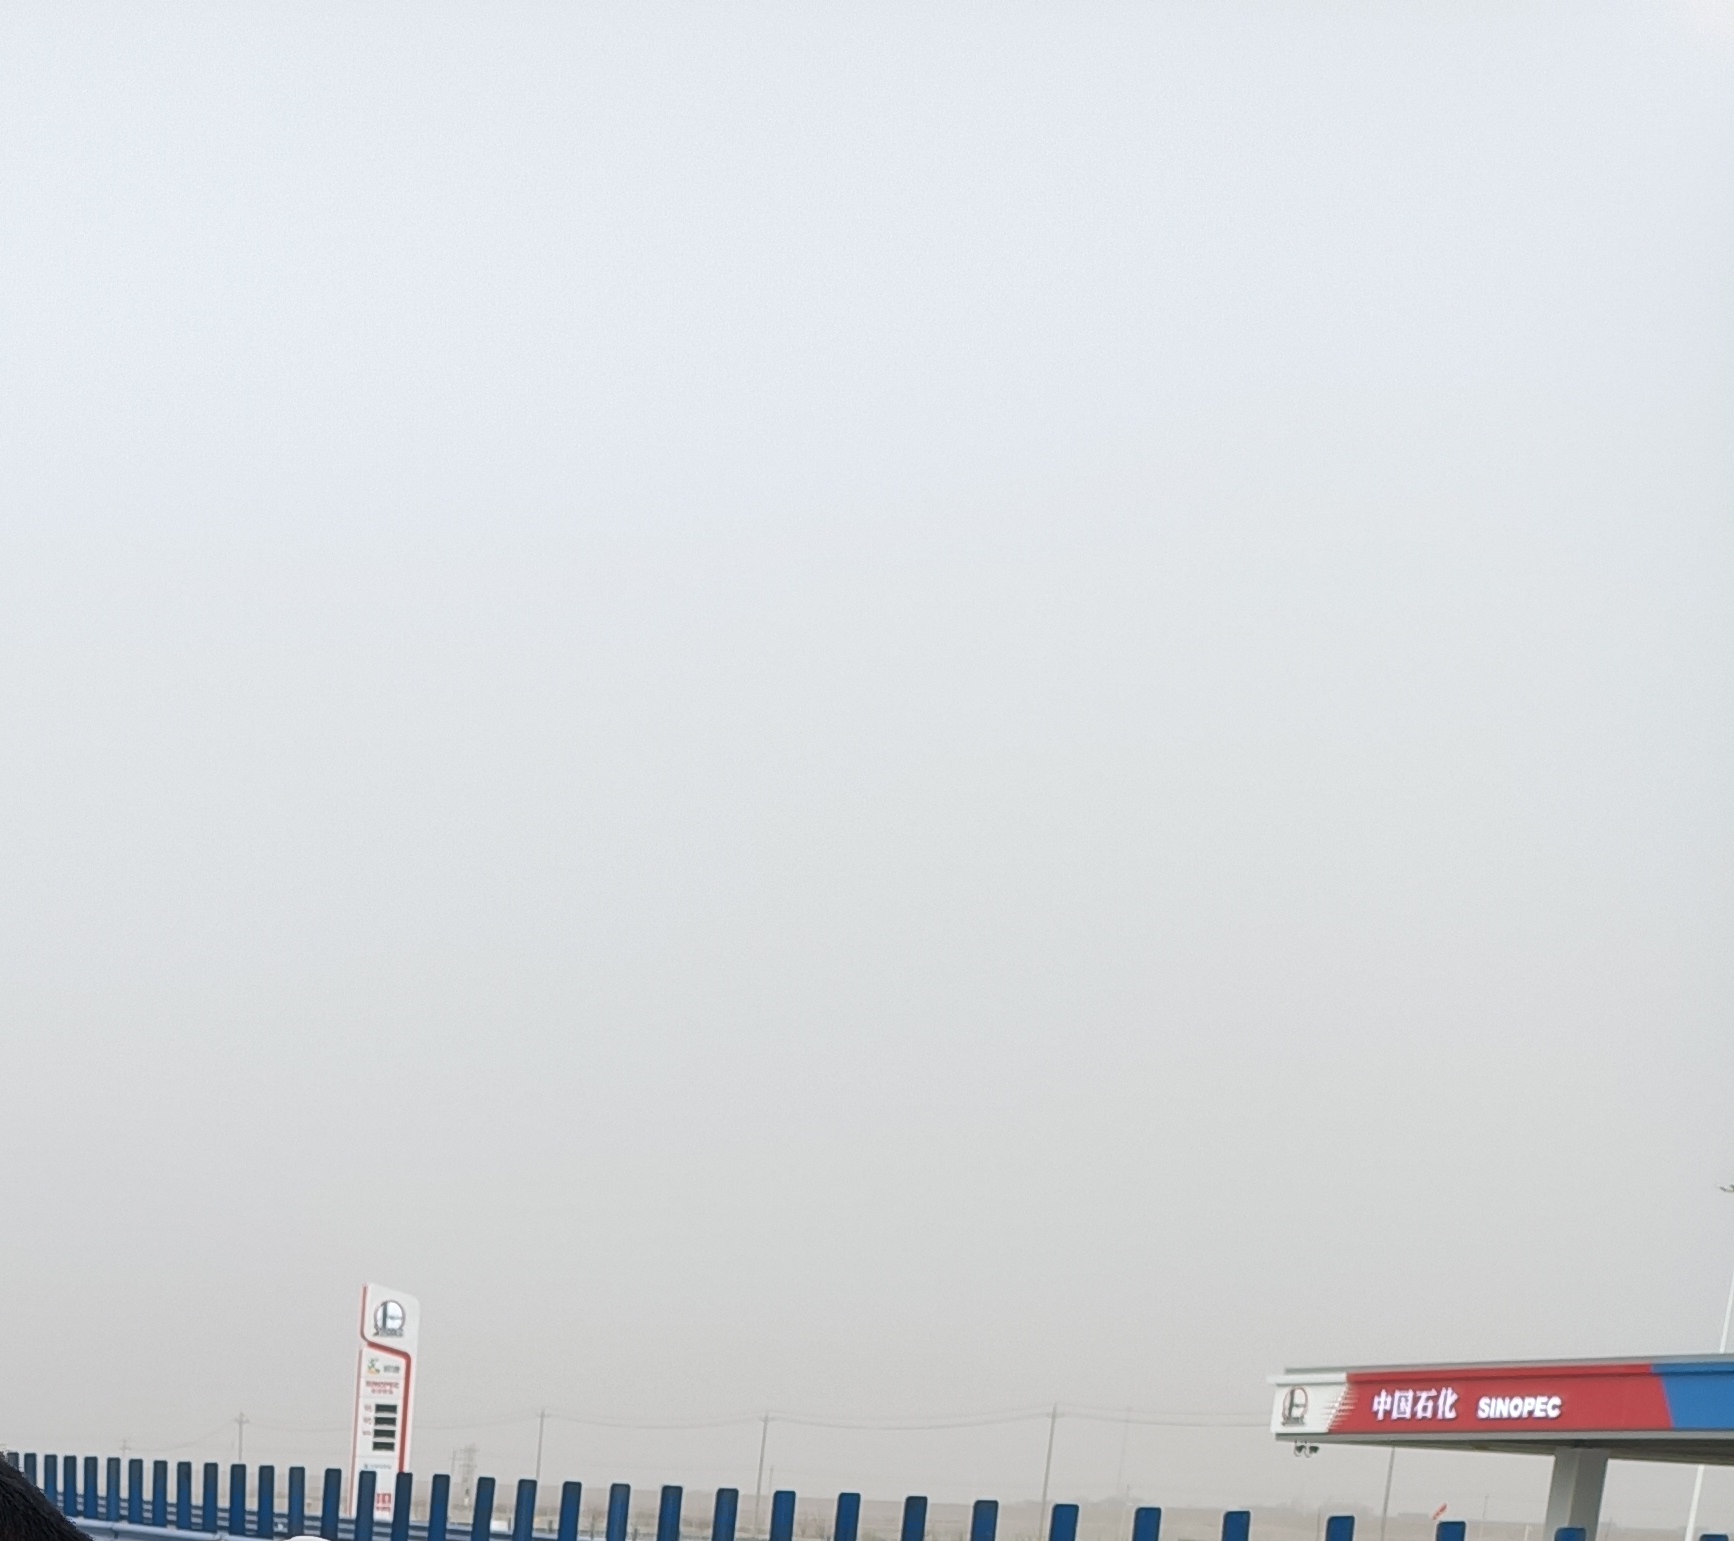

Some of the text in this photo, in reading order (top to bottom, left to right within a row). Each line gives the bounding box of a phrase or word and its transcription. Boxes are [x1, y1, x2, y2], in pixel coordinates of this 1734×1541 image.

[1371, 1386, 1459, 1421] 中国石化
[1476, 1395, 1562, 1420] SINOPEC
